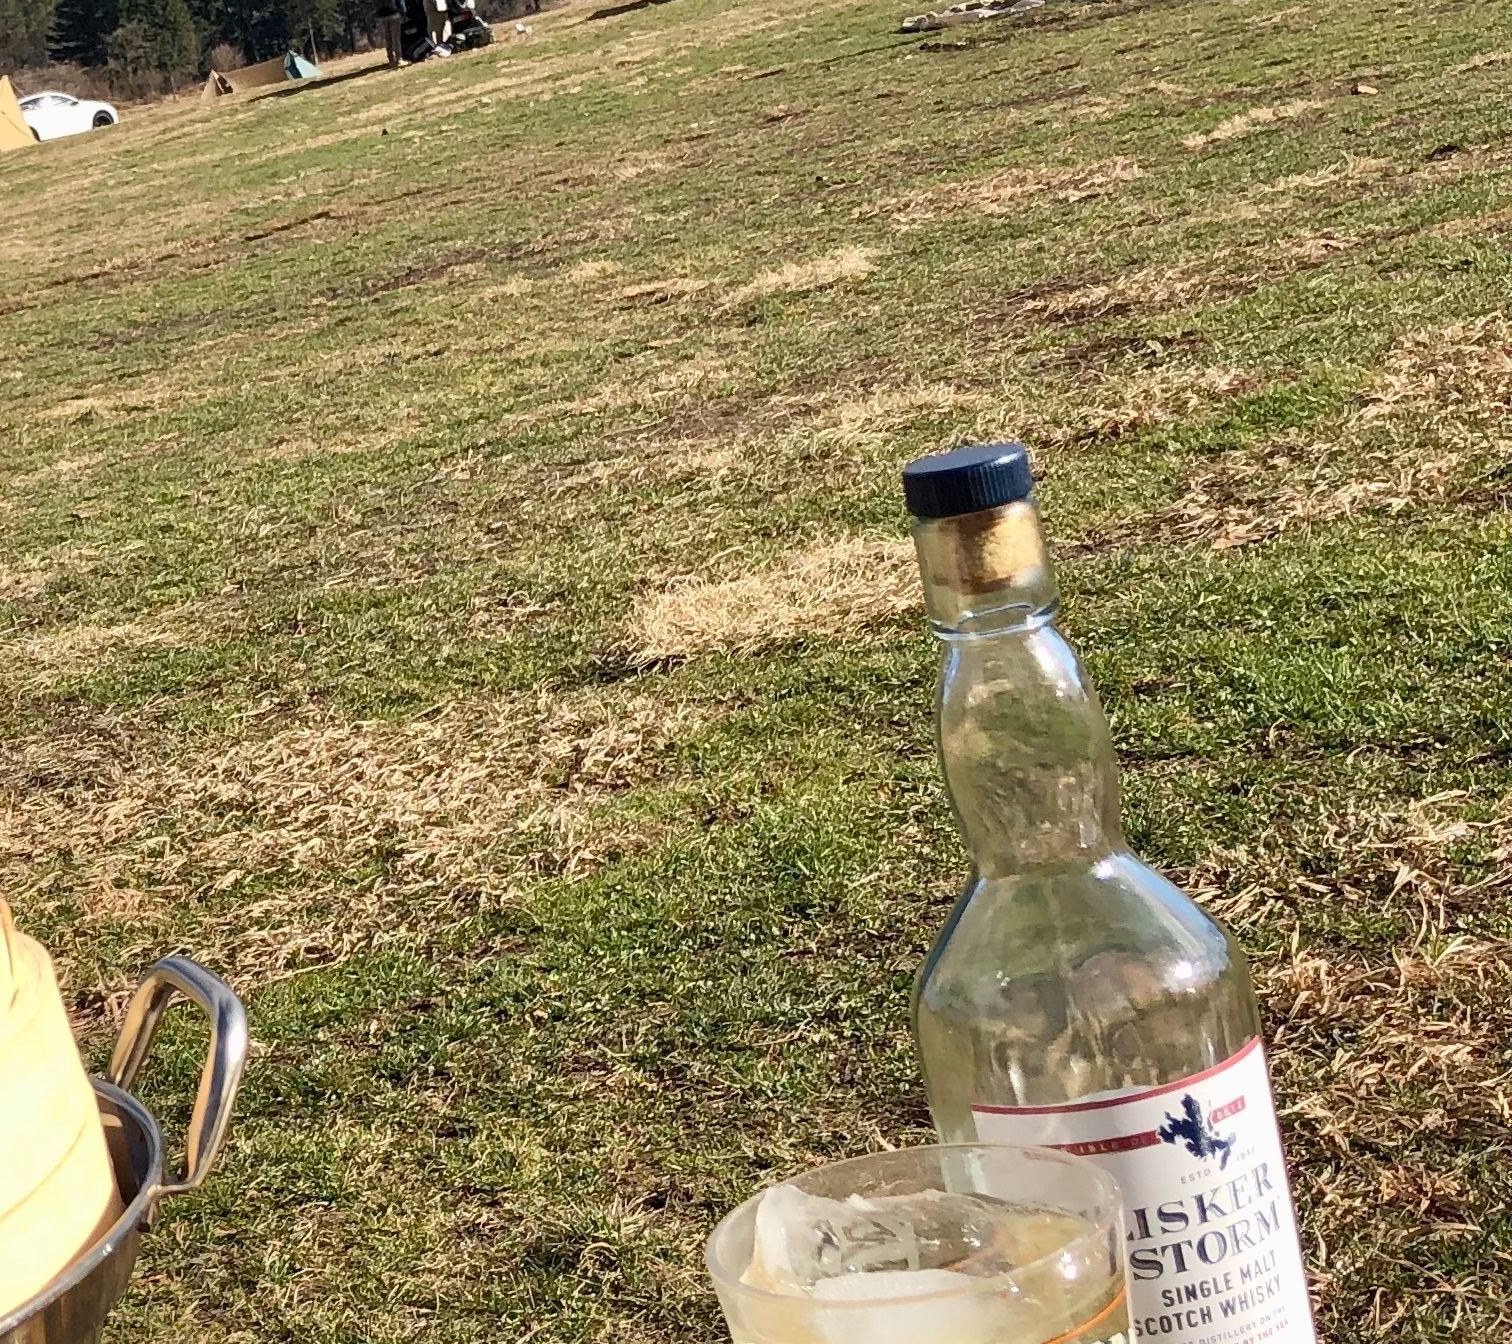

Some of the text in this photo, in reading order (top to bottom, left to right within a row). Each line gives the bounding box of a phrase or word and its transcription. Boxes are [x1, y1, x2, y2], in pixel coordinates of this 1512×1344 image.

[1180, 1168, 1212, 1185] ESTD
[1129, 1200, 1282, 1281] STORM
[1161, 1248, 1278, 1308] SINGLE MALT
[1133, 1273, 1282, 1338] SCOTCH WHISKY
[1259, 1314, 1271, 1326] ON
[1257, 1327, 1274, 1342] THE
[1275, 1318, 1289, 1332] SEA
